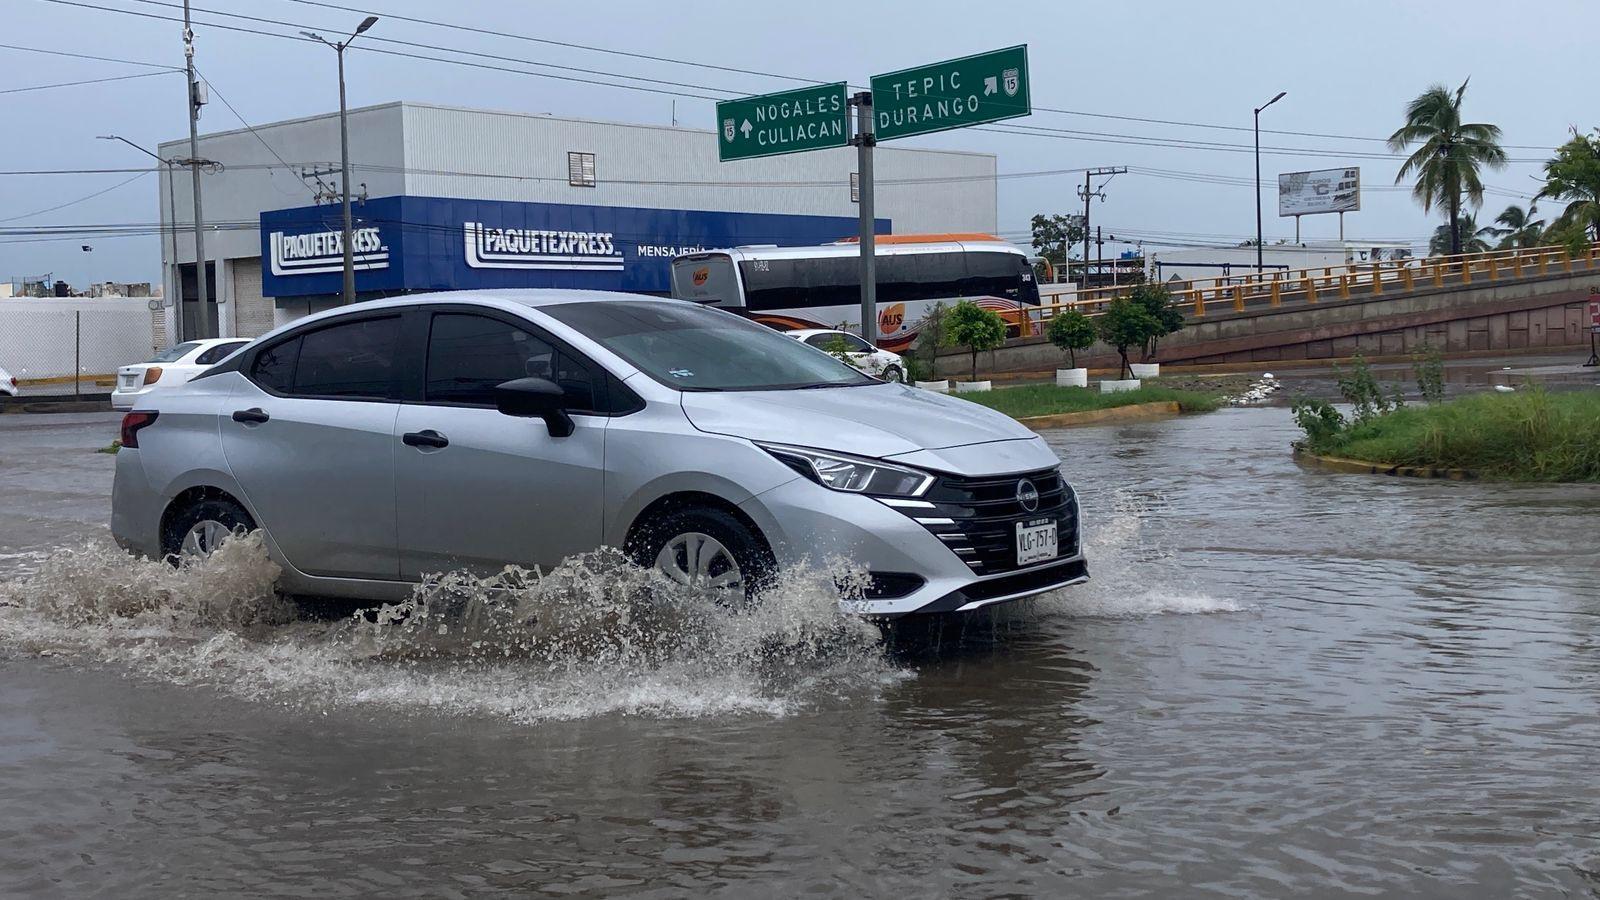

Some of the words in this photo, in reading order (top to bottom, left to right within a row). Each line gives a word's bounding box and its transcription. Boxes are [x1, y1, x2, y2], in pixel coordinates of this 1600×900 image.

[892, 71, 961, 101] TEPIC
[1006, 78, 1016, 90] 15
[756, 94, 840, 123] NOGALES
[879, 94, 979, 129] DURANGO
[726, 126, 735, 138] 15
[758, 119, 842, 146] CULIACAN
[283, 227, 381, 259] PAQUETEXRESS
[484, 228, 614, 255] PAQUETEXPRESS
[882, 312, 903, 327] AUS
